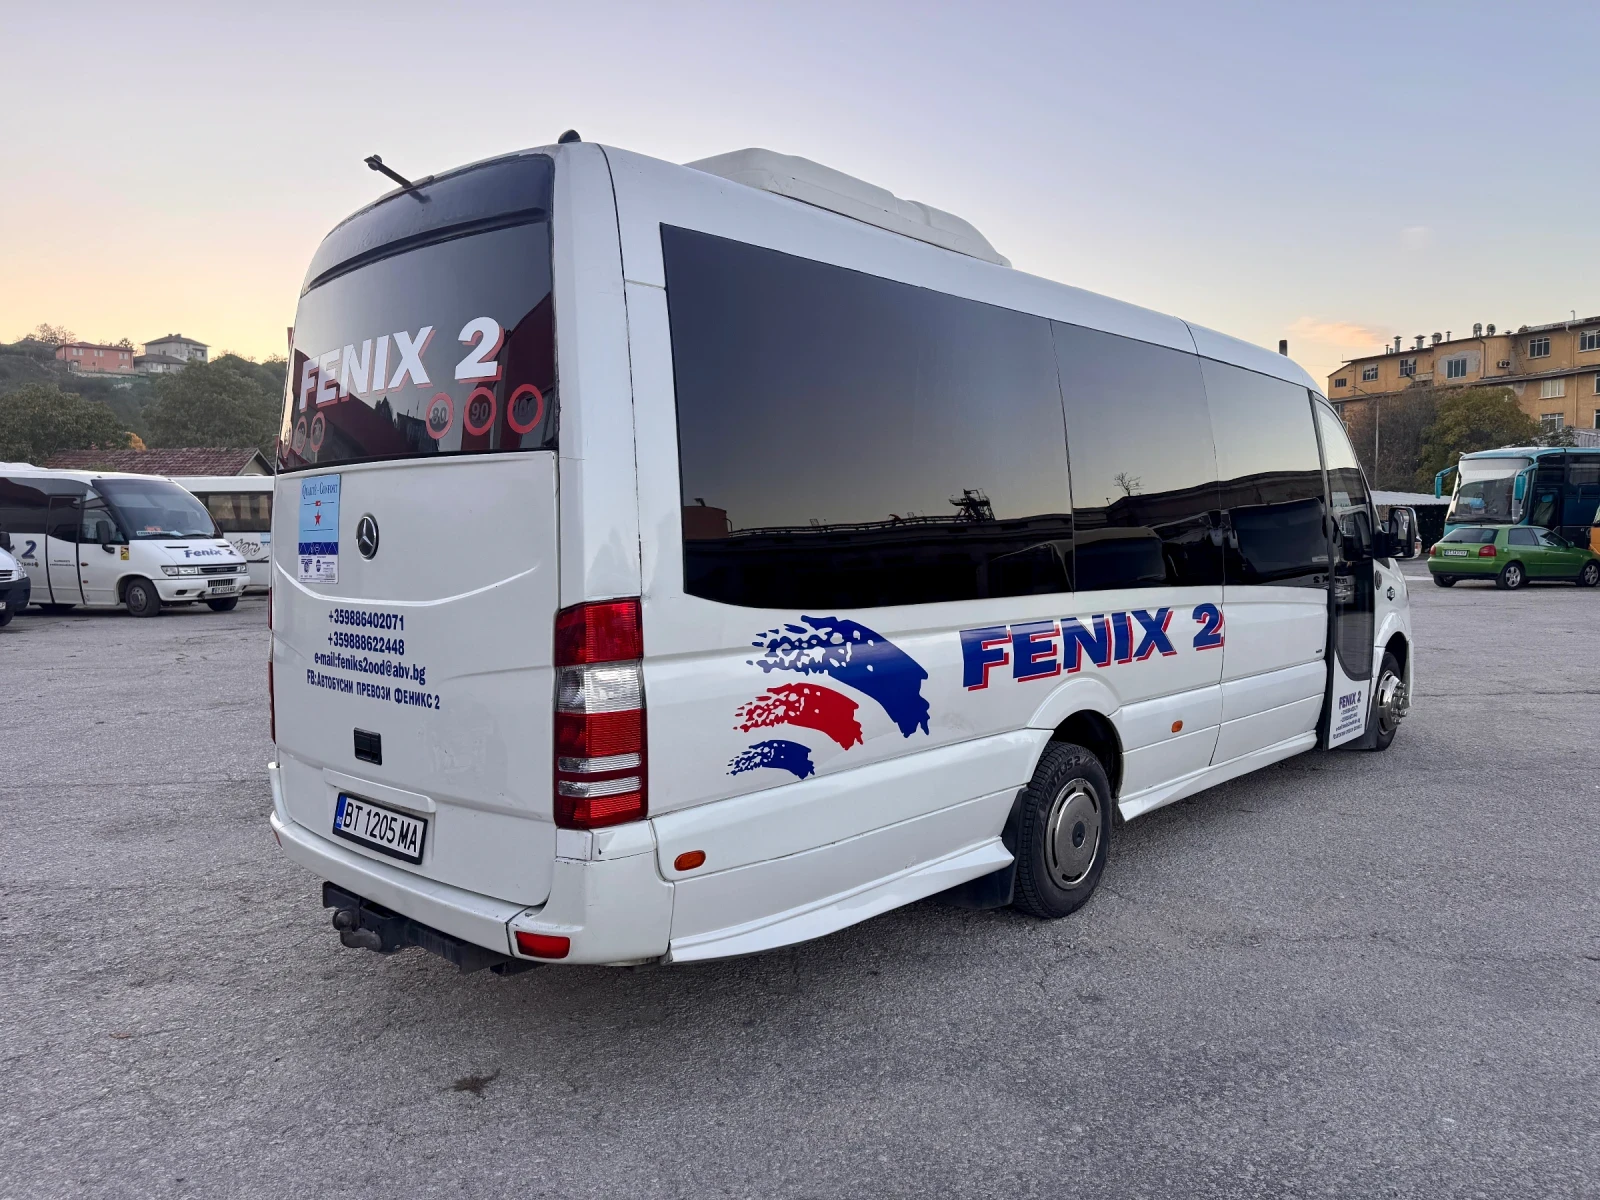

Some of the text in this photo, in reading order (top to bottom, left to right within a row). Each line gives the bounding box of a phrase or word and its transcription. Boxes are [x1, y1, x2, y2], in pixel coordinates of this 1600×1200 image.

[299, 316, 505, 413] FENIX 2
[431, 407, 448, 425] 80
[471, 402, 489, 420] 90
[21, 540, 37, 559] 2
[184, 548, 237, 558] Fenix 2
[328, 608, 404, 631] +359886402071
[327, 631, 405, 656] +359888622448
[959, 603, 1225, 692] FENIX 2
[314, 652, 426, 686] e-mail:feniks2ood@abv.bg
[356, 681, 391, 702] ПРЕВОЗИ
[394, 687, 432, 709] ФЕНИКС
[434, 695, 440, 710] 2
[1338, 692, 1357, 710] FENIX
[1357, 690, 1362, 703] 2
[343, 802, 363, 831] BT
[365, 809, 398, 844] 1205
[397, 820, 417, 853] MA
